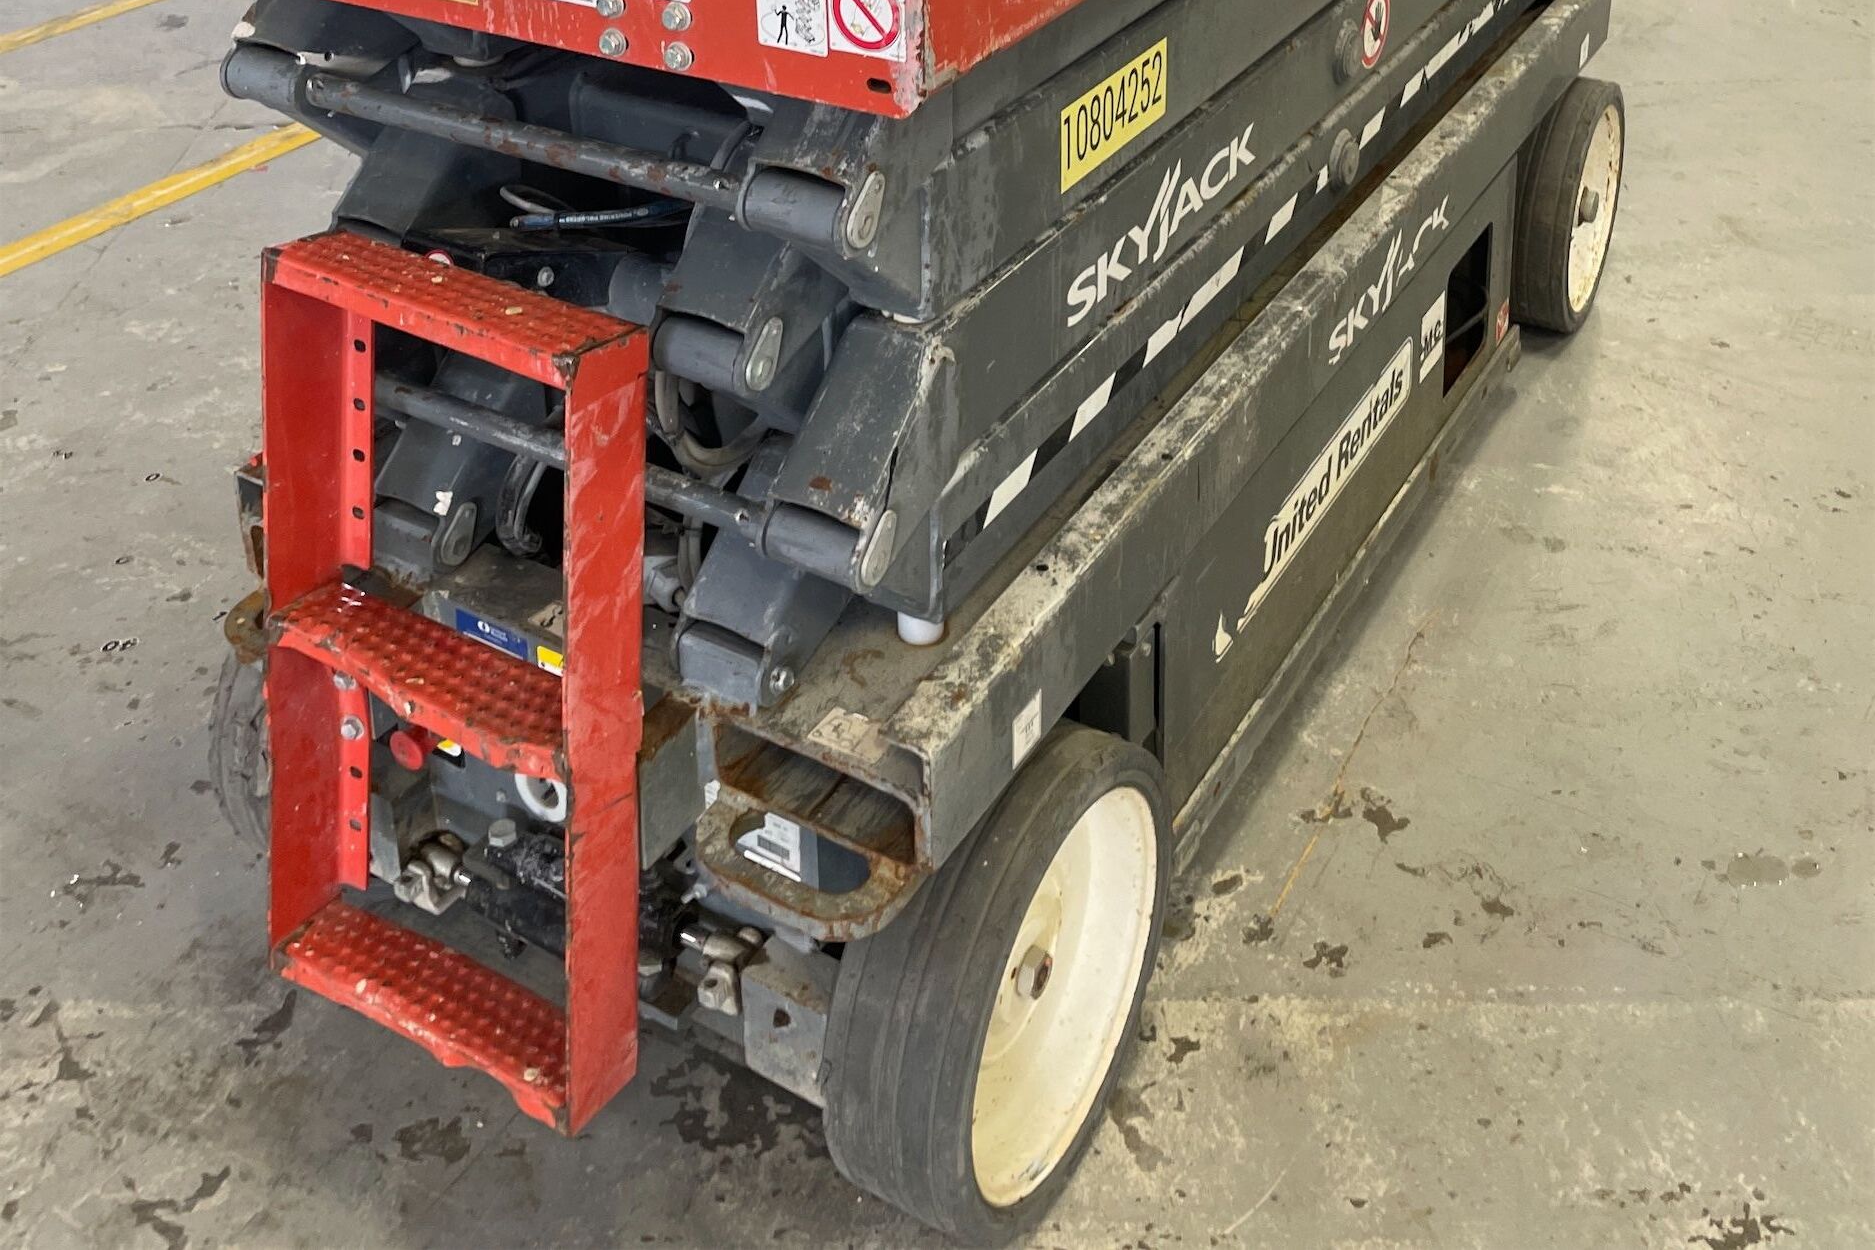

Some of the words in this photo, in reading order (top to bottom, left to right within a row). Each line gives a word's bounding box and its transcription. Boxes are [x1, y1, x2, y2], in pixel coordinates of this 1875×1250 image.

[1064, 51, 1163, 170] 10804252
[1066, 122, 1257, 327] SKYJACK
[1336, 368, 1404, 481] Rentals
